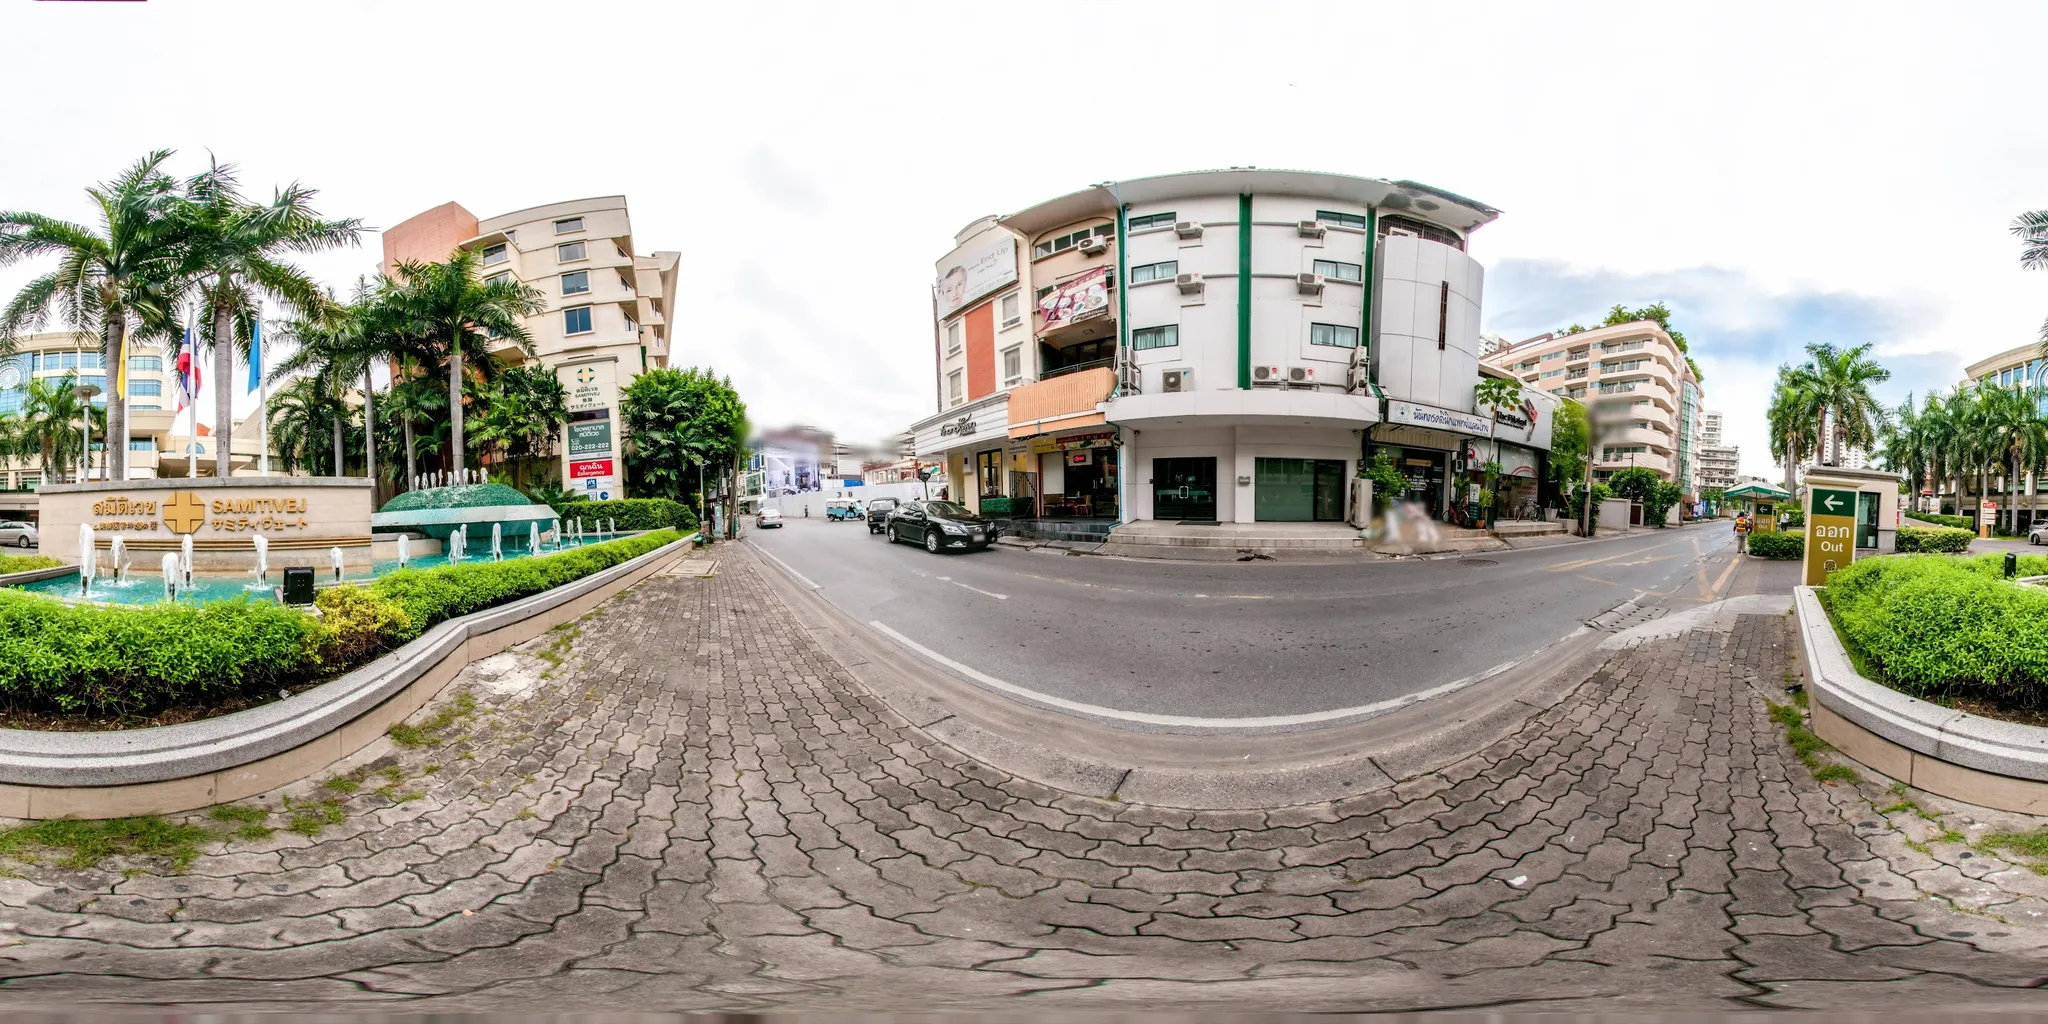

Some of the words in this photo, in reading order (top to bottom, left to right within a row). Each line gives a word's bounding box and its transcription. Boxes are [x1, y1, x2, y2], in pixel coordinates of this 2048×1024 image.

[980, 252, 995, 264] End
[996, 247, 1009, 256] Up
[571, 442, 610, 451] 020-222-222
[579, 461, 603, 471] ฉุกเฉิน
[93, 495, 156, 516] สมิติเวช
[212, 498, 308, 514] SAMITIVEJ
[212, 517, 308, 531] サミティヴェート
[1815, 525, 1850, 539] ออก
[1820, 541, 1844, 552] Out
